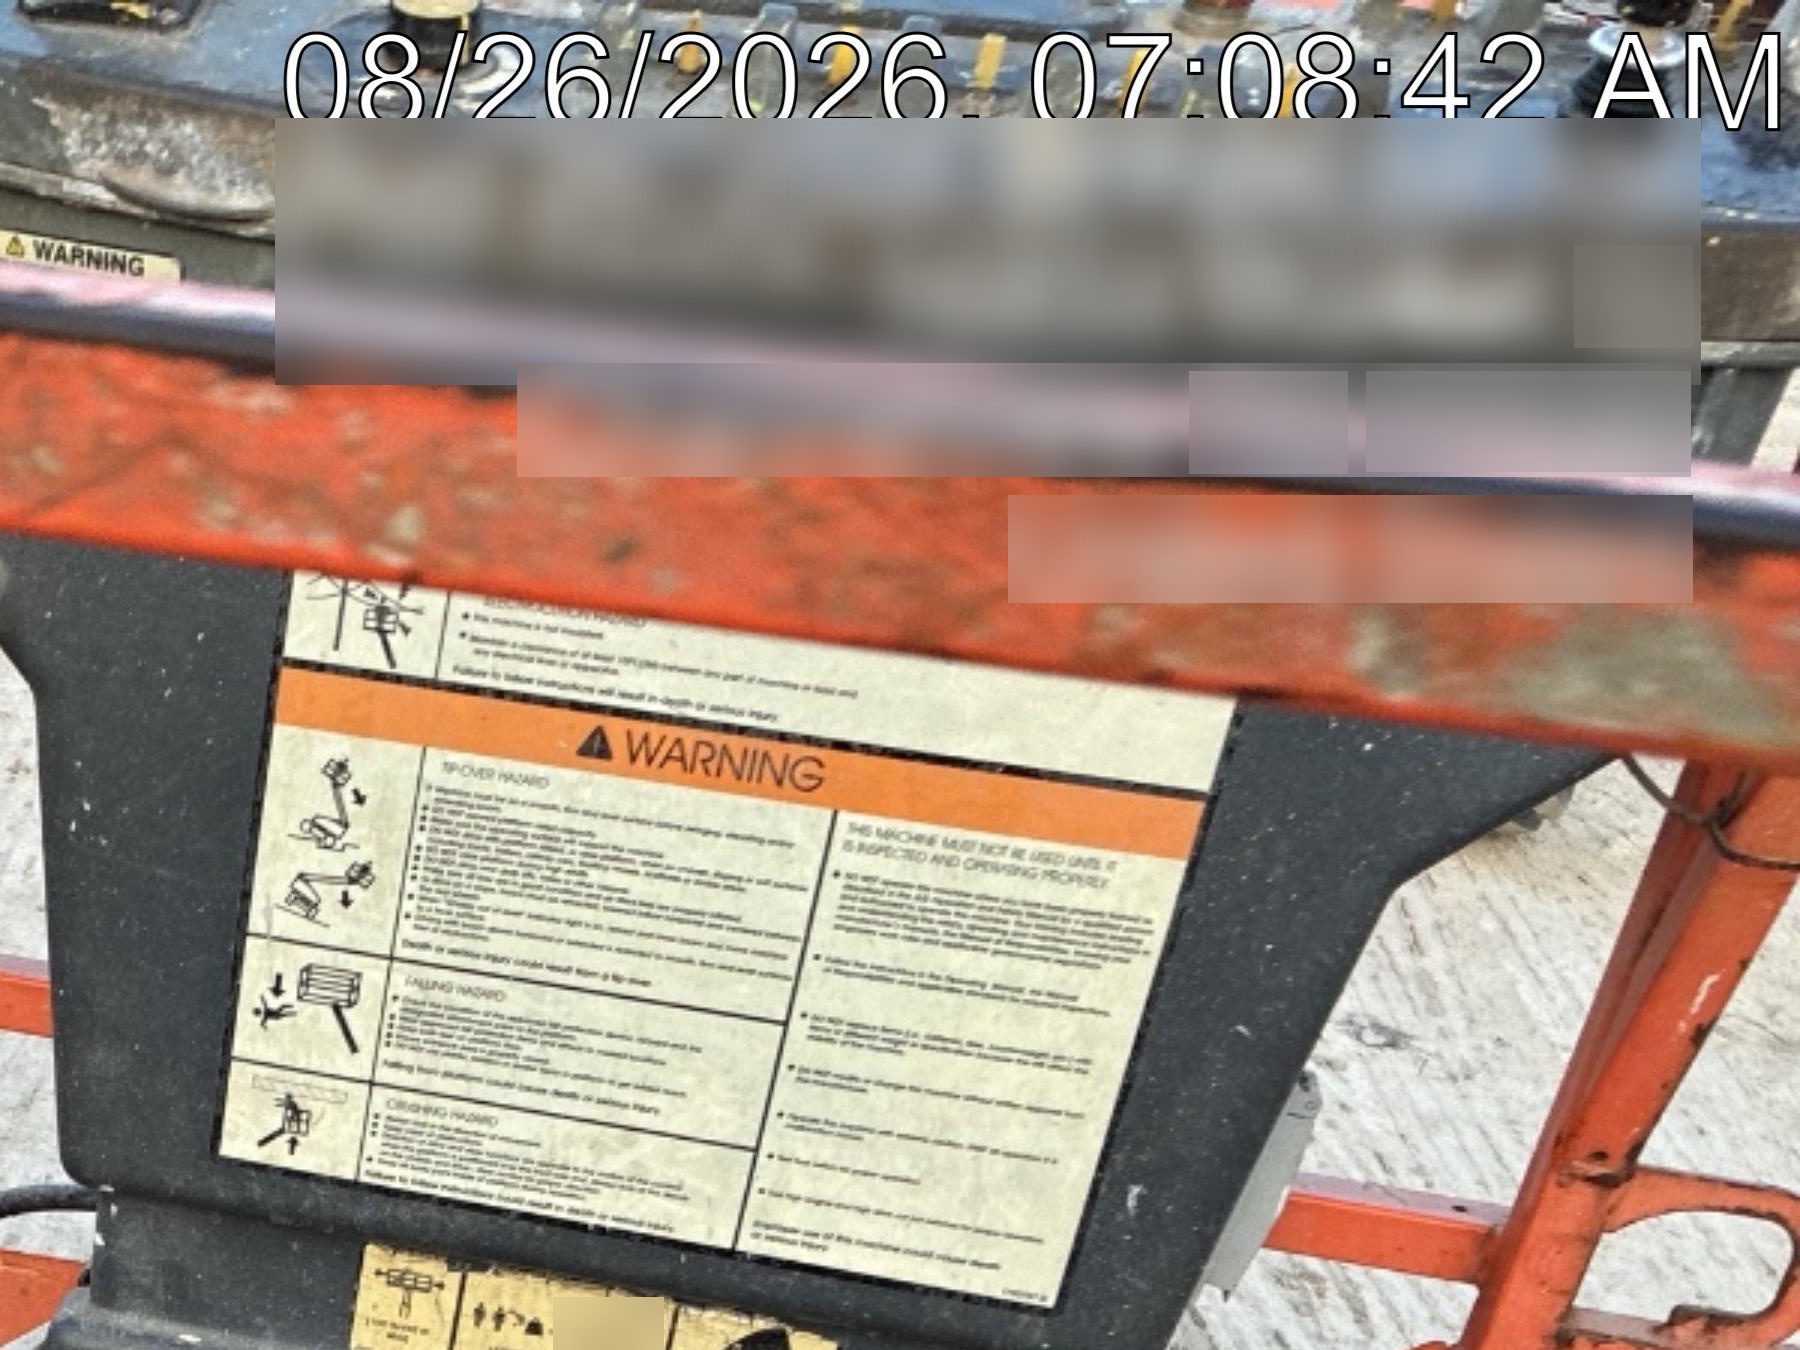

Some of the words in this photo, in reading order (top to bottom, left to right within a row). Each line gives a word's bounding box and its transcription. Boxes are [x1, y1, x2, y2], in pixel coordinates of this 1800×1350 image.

[32, 238, 145, 278] WARNING
[495, 767, 551, 789] HAZARD
[624, 728, 827, 793] WARNING
[840, 837, 856, 852] IS
[855, 840, 929, 864] INSPECTED
[929, 851, 963, 869] AND
[960, 856, 1040, 880] OPERATING
[845, 820, 873, 838] THIS
[871, 824, 939, 847] MACHINE
[940, 835, 978, 853] MUST
[977, 840, 1009, 858] NOT
[1008, 845, 1028, 861] BE
[1028, 848, 1067, 867] USED
[1065, 853, 1103, 872] UNTIL
[1103, 859, 1119, 875] IT
[403, 973, 454, 994] FALLING
[454, 982, 508, 1003] HAZARD
[385, 1097, 449, 1119] CRUSHING
[449, 1108, 499, 1128] HAZARD
